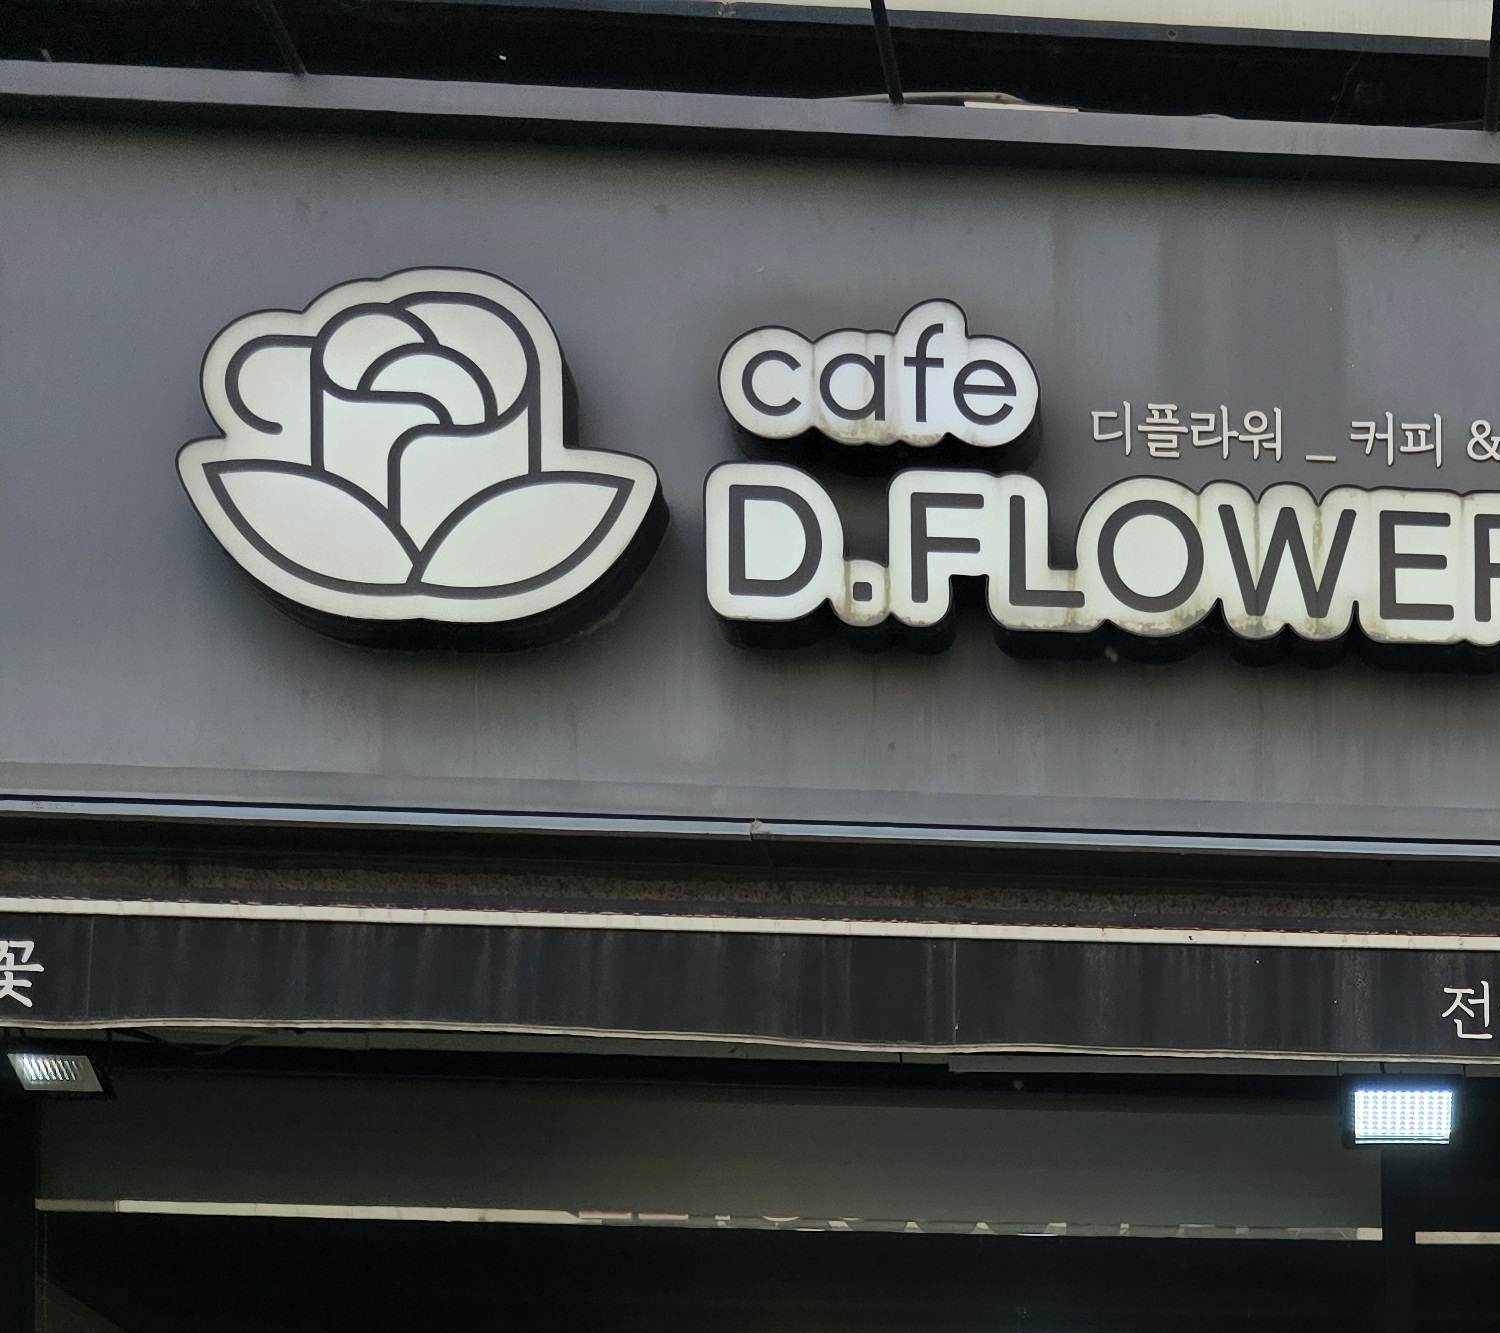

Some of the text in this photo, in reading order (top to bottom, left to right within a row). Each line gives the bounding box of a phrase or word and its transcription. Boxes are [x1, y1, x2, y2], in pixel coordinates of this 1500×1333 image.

[742, 322, 1017, 426] cafe
[1091, 401, 1284, 461] 디플라워
[1350, 412, 1445, 468] 커피
